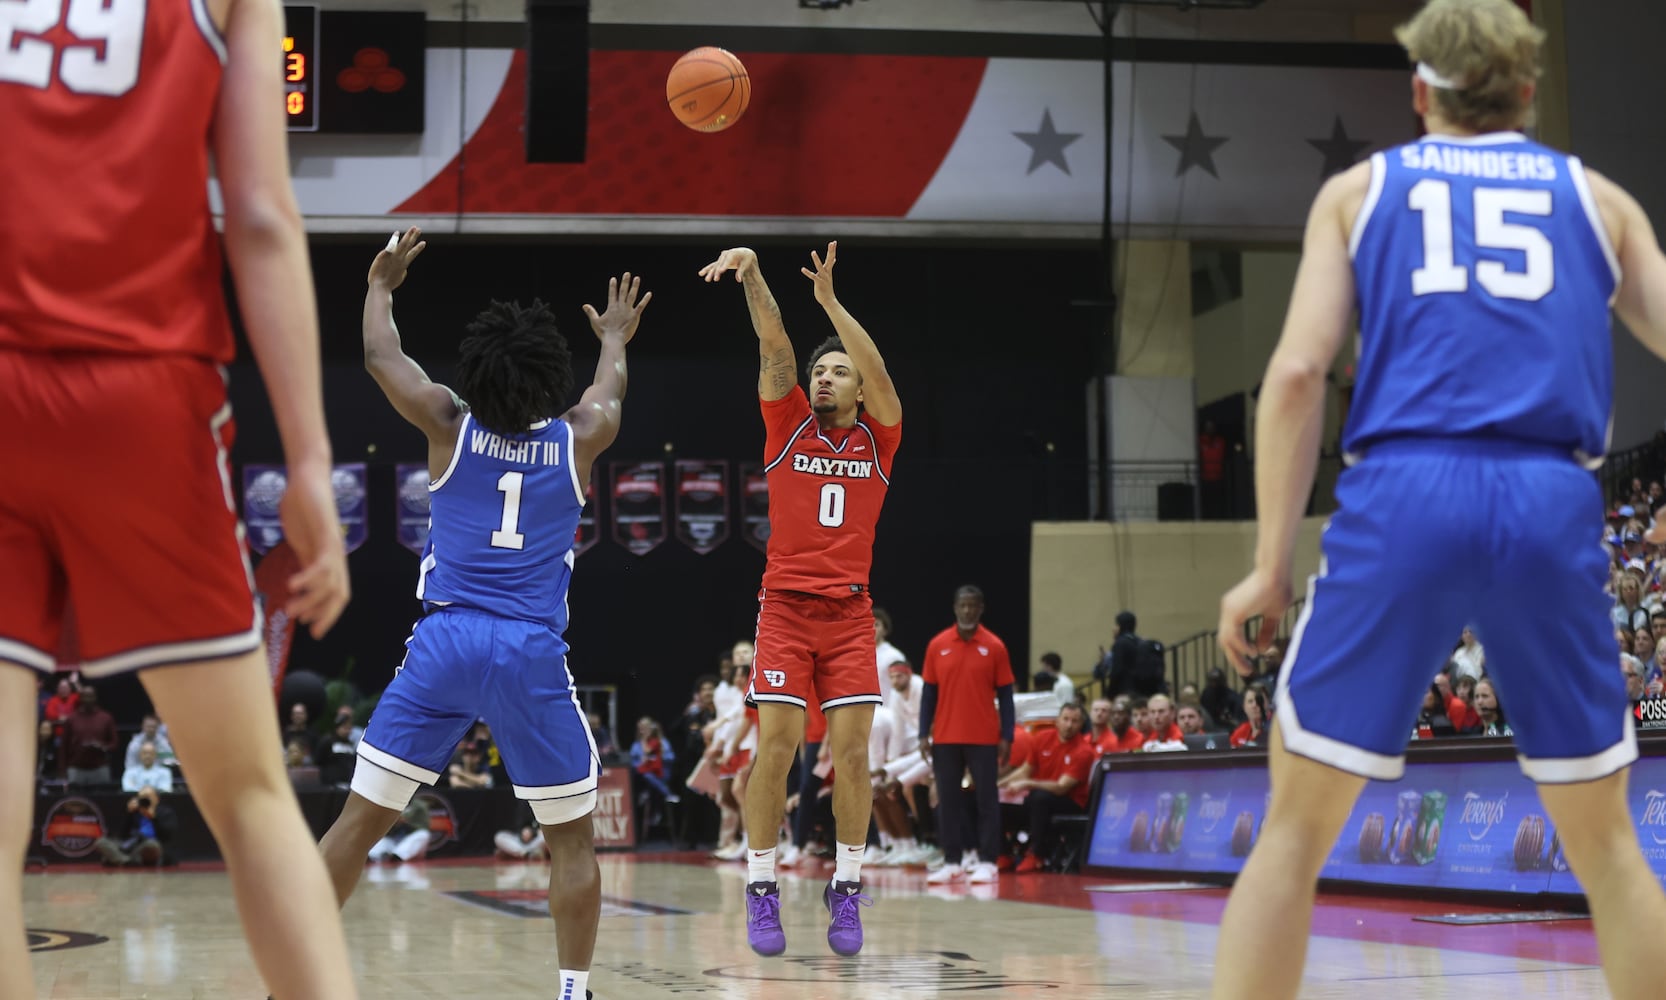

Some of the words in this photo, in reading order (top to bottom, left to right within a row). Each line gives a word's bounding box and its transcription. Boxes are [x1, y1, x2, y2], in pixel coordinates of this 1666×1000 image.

[0, 0, 148, 98] 29
[1401, 144, 1557, 181] SAUNDERS
[1408, 178, 1555, 302] 15
[471, 429, 541, 465] WRIGHT
[542, 441, 560, 466] III
[792, 453, 873, 479] DAYTON
[490, 470, 525, 551] 1
[818, 482, 846, 528] 0
[592, 815, 628, 840] NLY
